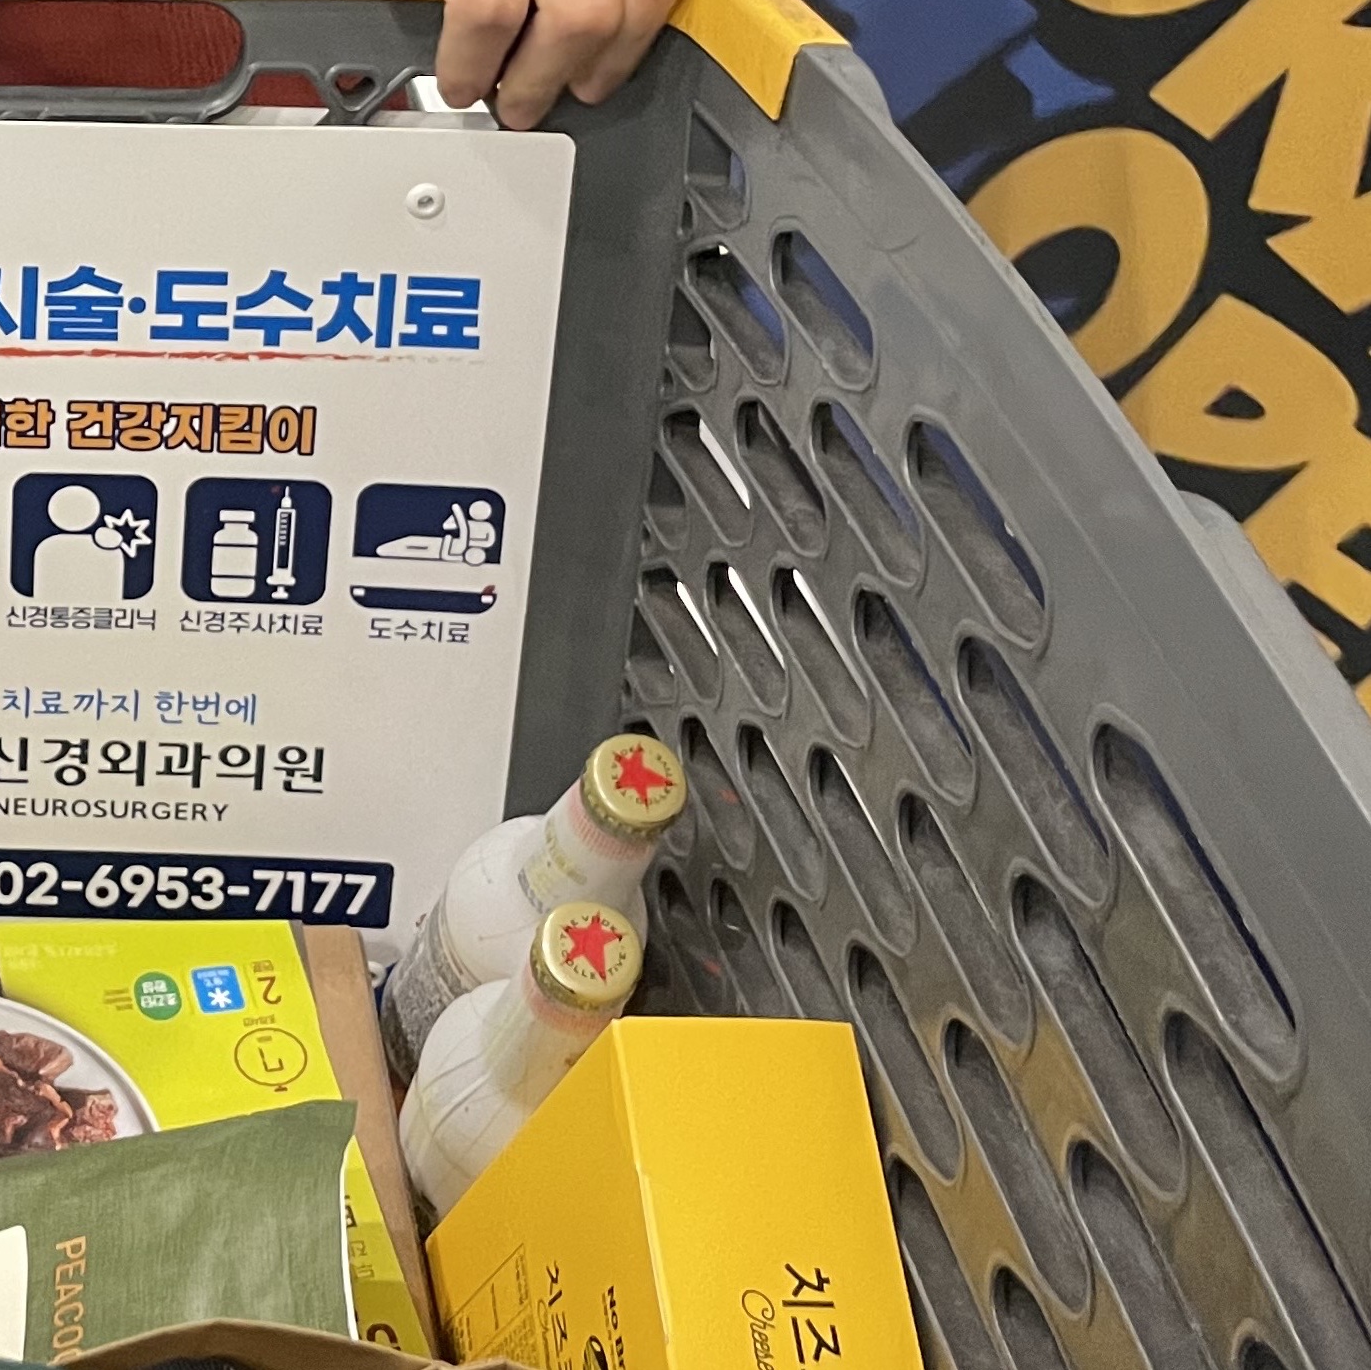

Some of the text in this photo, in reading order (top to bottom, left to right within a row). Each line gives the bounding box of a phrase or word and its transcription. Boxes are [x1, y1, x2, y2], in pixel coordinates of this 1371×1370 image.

[67, 399, 317, 456] 건강지킴이
[5, 605, 157, 631] 신경통증클리닉
[179, 609, 324, 636] 신경주사치료
[368, 617, 471, 644] 도수치료
[2, 686, 140, 722] 치료까지
[154, 690, 258, 725] 한번에
[257, 976, 282, 1005] 2
[781, 1263, 843, 1370] 치즈
